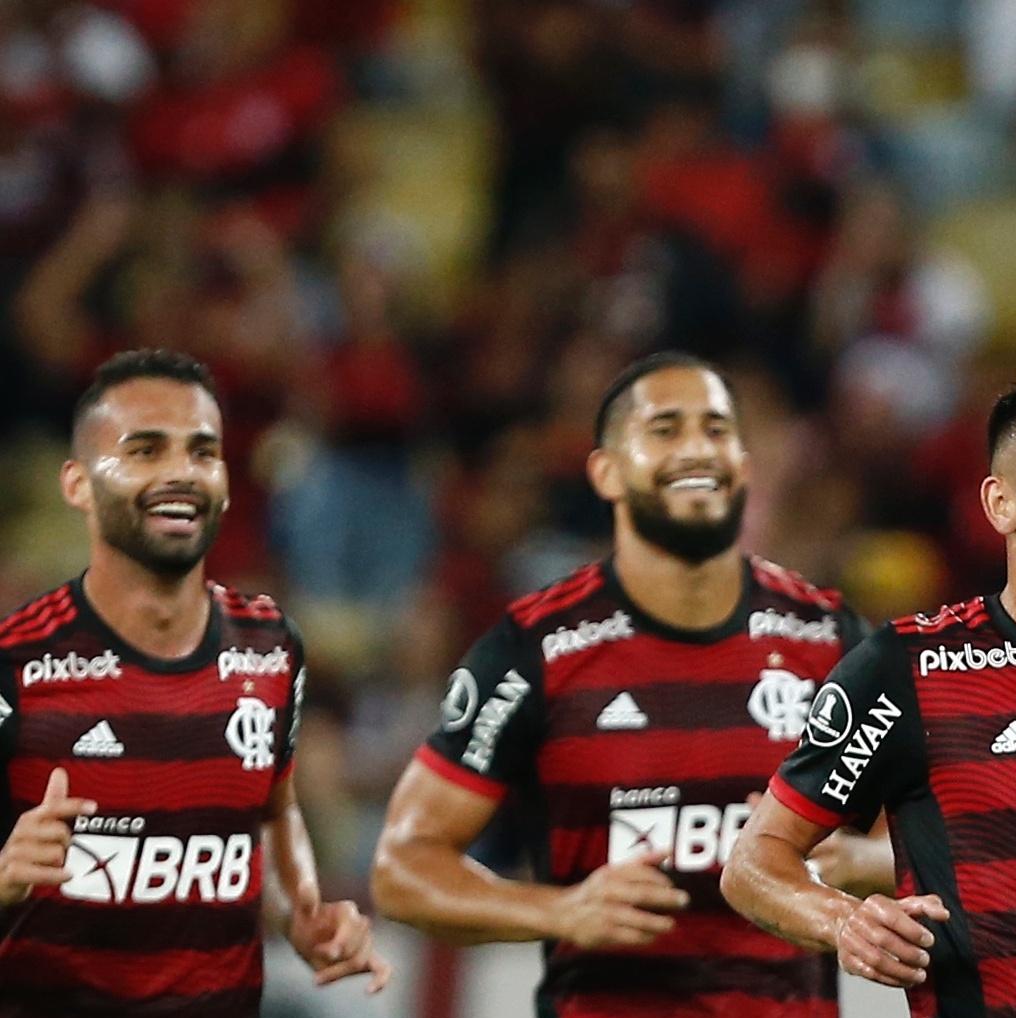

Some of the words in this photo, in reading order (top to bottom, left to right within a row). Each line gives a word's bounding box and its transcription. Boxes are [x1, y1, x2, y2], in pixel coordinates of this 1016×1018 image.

[22, 649, 122, 687] pixbet
[217, 645, 290, 681] pixbet
[821, 692, 902, 805] HAVAN
[74, 814, 146, 834] banco
[675, 803, 752, 873] BR
[131, 833, 253, 902] BRB
